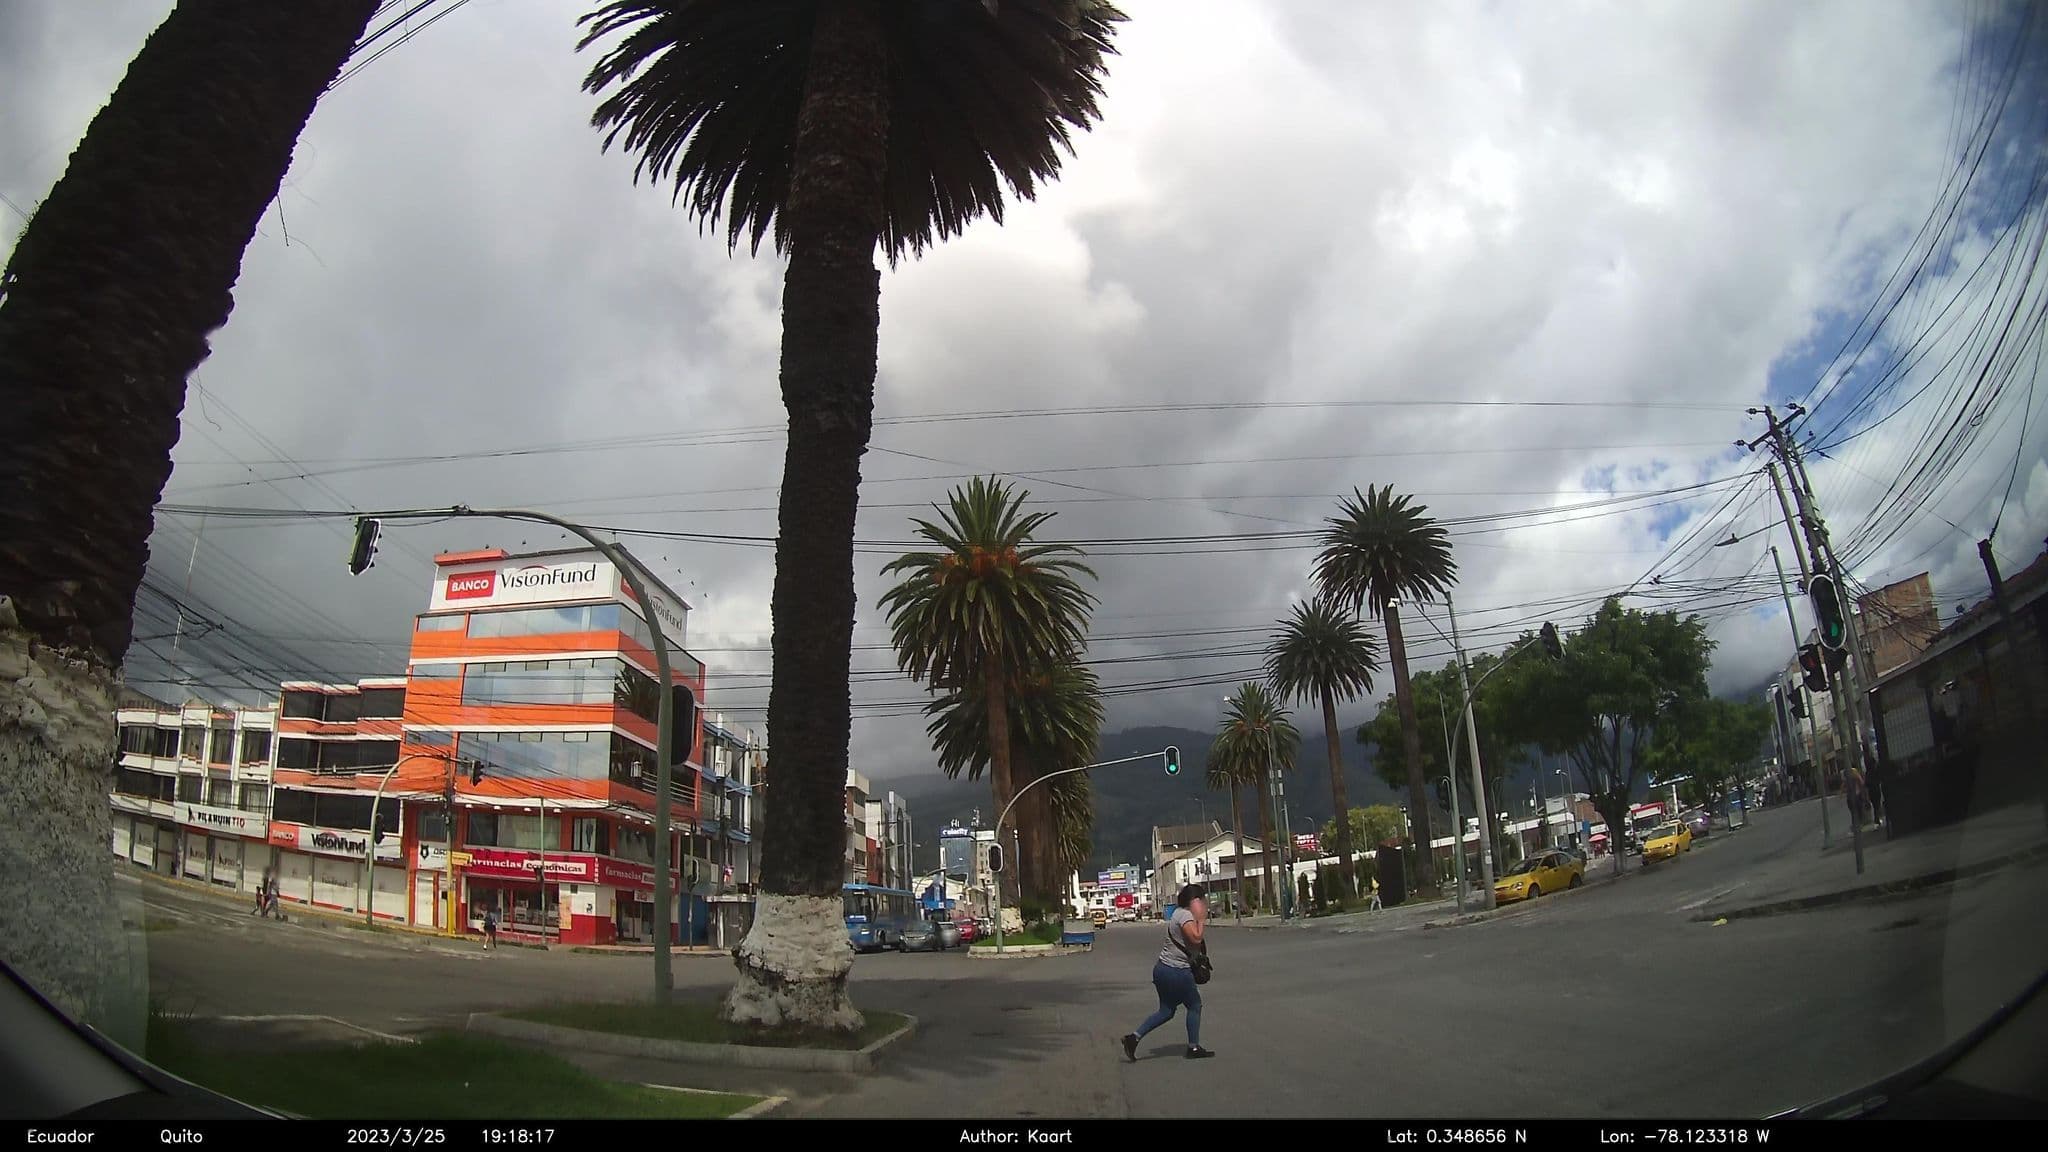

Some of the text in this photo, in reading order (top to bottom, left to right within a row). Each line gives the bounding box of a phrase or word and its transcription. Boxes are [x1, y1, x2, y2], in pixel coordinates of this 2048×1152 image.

[451, 564, 597, 592] BANCO VisionFund
[467, 857, 523, 869] armacias
[605, 865, 642, 881] farmacias
